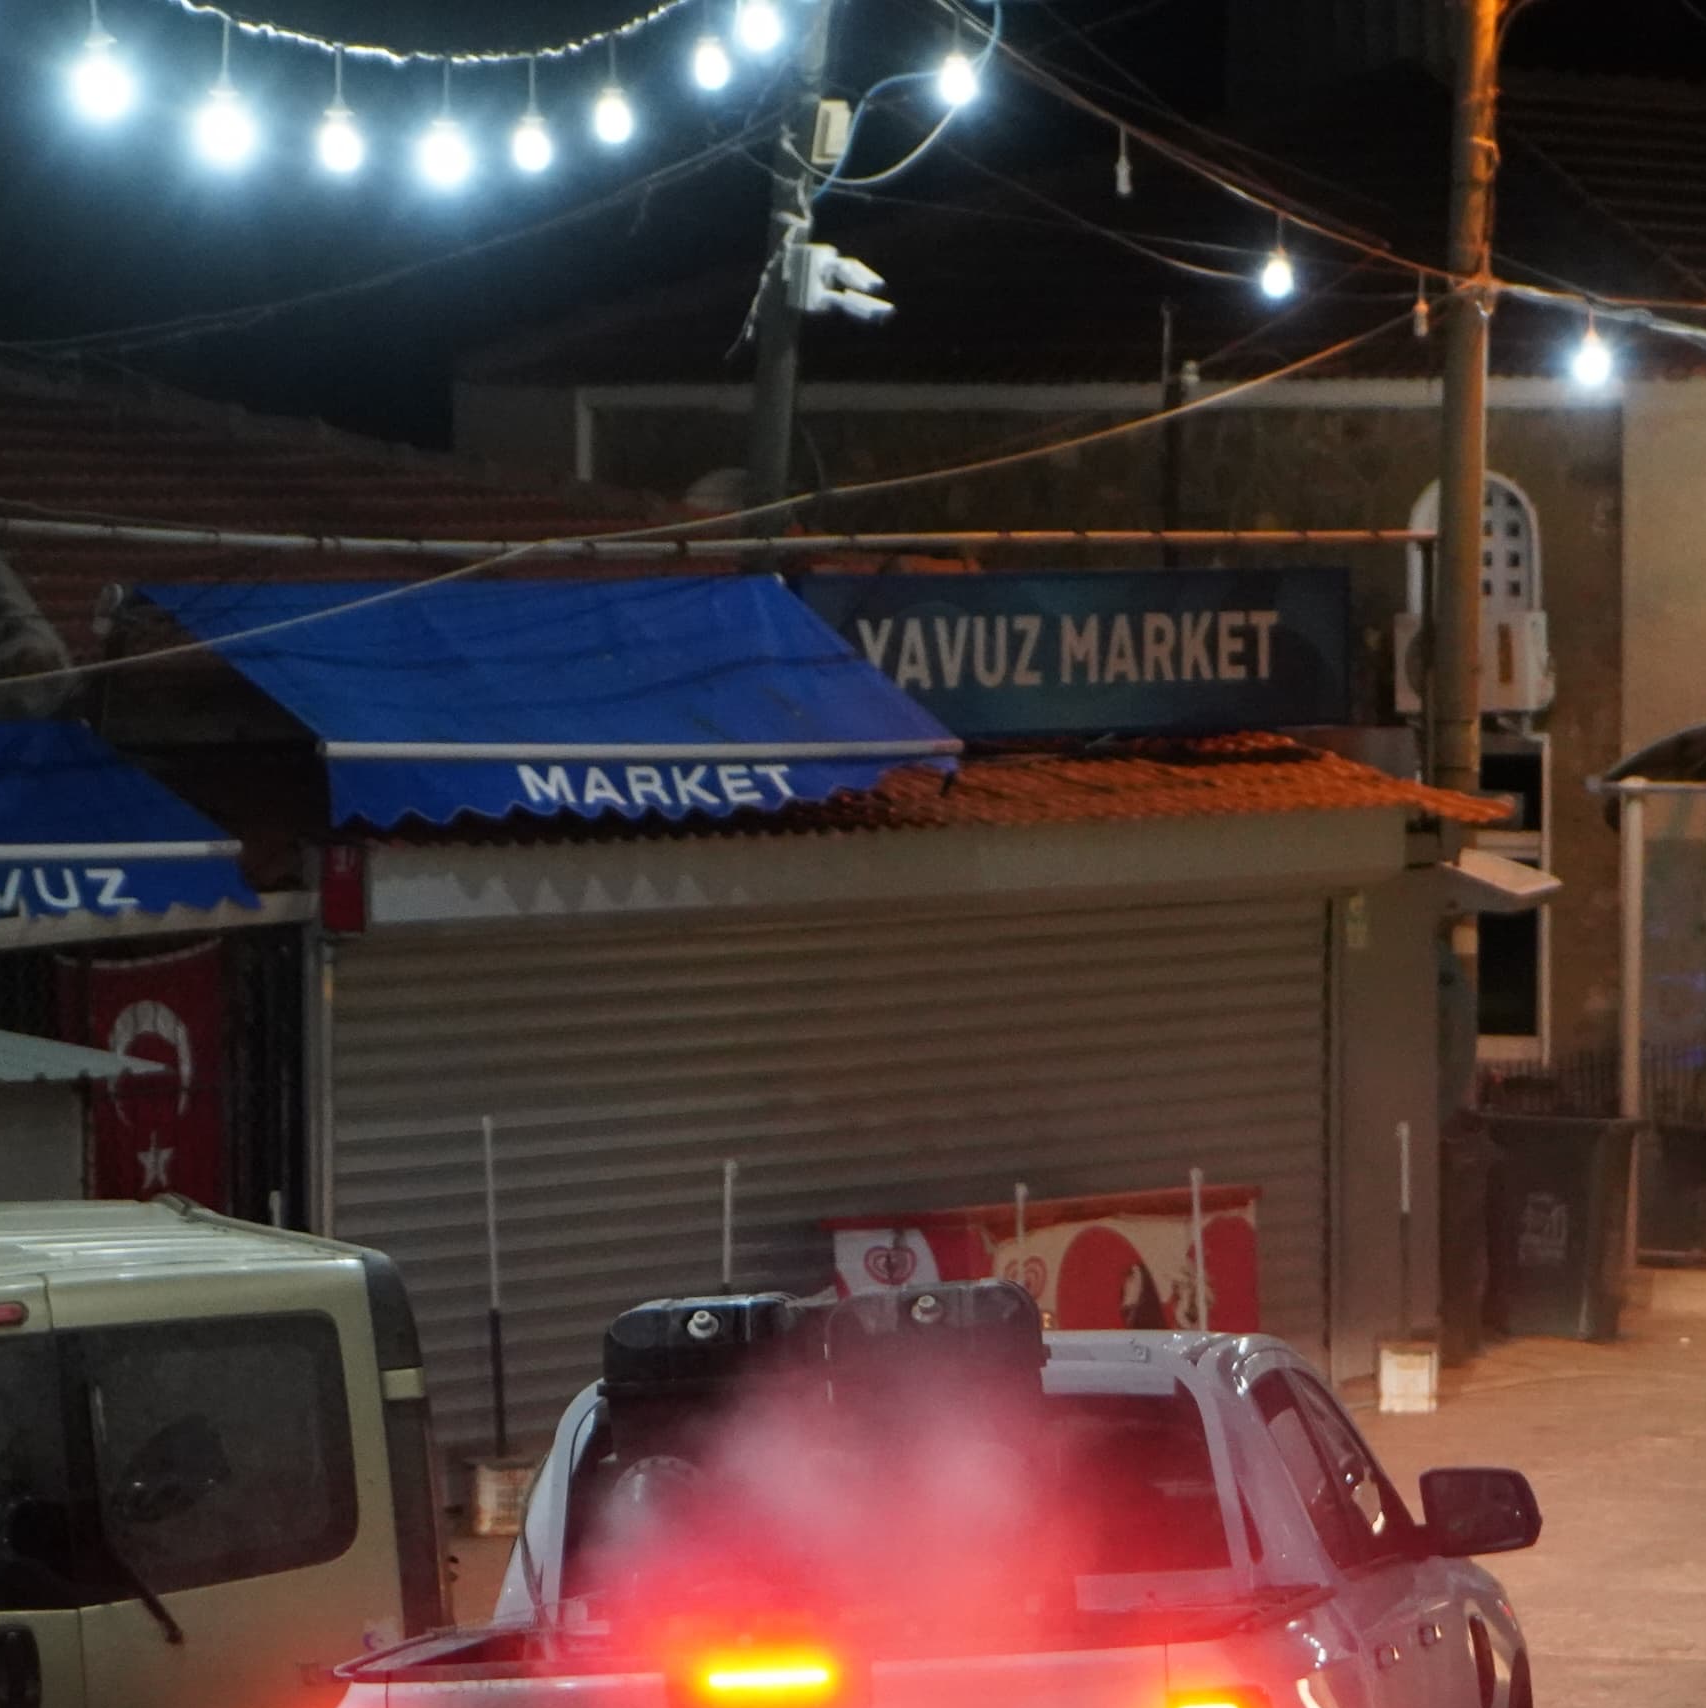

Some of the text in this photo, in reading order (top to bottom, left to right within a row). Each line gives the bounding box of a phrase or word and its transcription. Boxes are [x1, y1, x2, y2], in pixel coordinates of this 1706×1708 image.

[857, 611, 1279, 690] YAVUZ MARKET
[517, 764, 793, 805] MARKET
